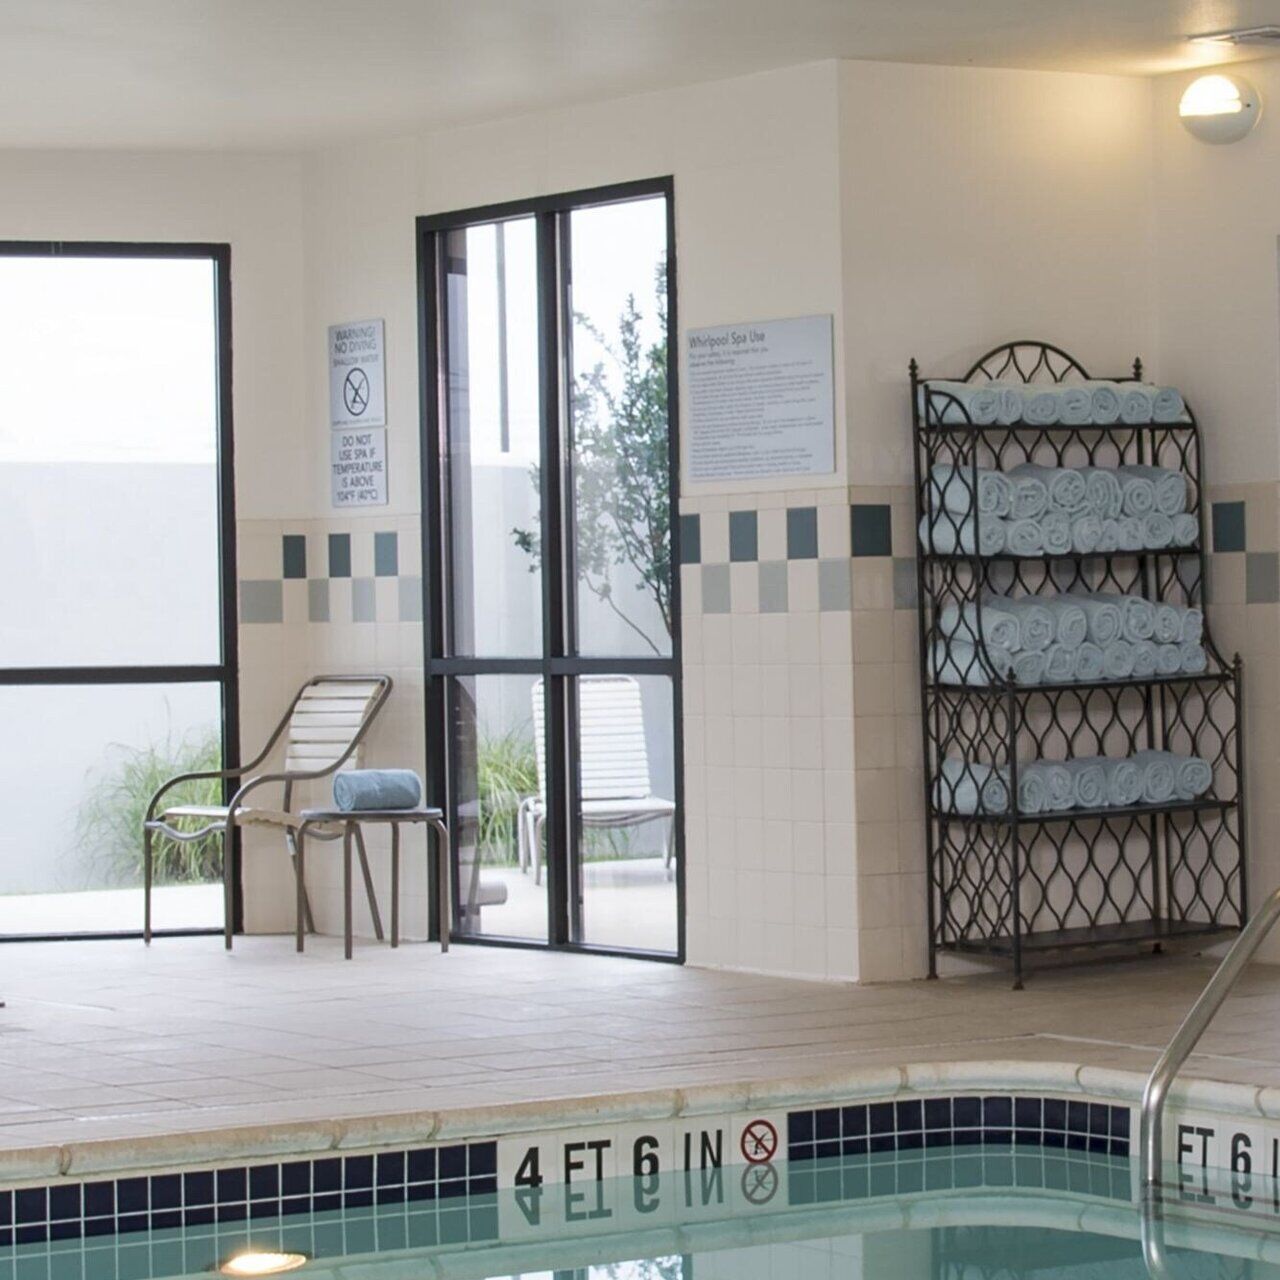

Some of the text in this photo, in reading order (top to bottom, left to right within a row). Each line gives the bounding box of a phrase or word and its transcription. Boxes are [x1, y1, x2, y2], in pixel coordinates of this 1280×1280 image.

[335, 338, 377, 354] NO DIVING
[689, 328, 765, 351] Whirlpool Spa Use
[342, 433, 372, 447] DO NOT
[338, 449, 352, 461] USE
[354, 448, 368, 460] SPA
[332, 460, 383, 475] TEMPERATURE
[350, 475, 374, 487] ABOVE
[1178, 1124, 1215, 1168] FT
[1231, 1132, 1252, 1174] 6
[514, 1129, 723, 1188] 4 FT 6 IN
